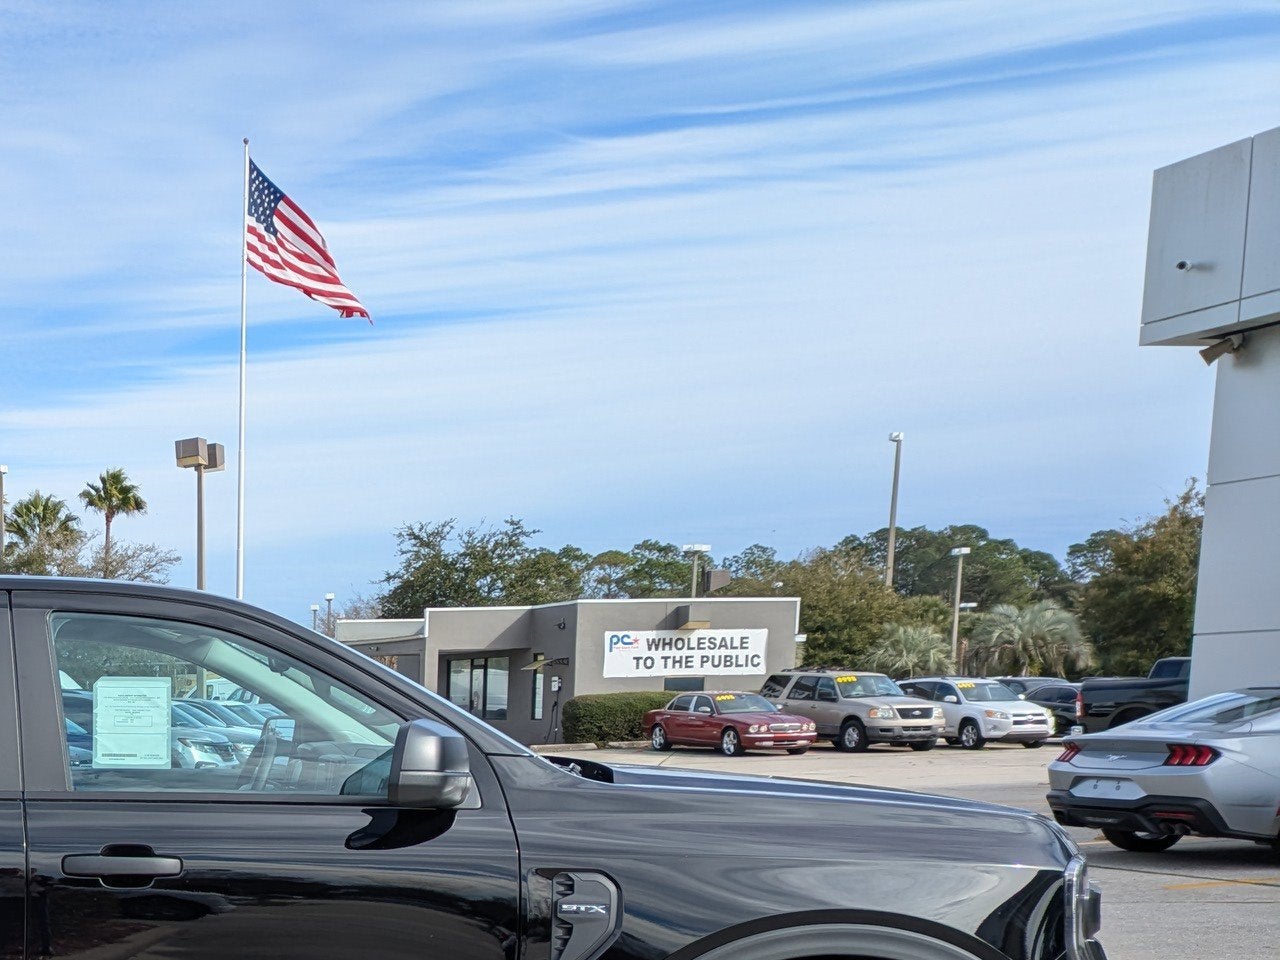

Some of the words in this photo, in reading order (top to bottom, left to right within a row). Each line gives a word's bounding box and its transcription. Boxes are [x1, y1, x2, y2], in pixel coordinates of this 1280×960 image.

[646, 636, 749, 652] WHOLESALE
[633, 656, 654, 669] TO
[661, 656, 694, 669] THE
[700, 654, 761, 669] PUBLIC
[561, 904, 606, 914] STX
